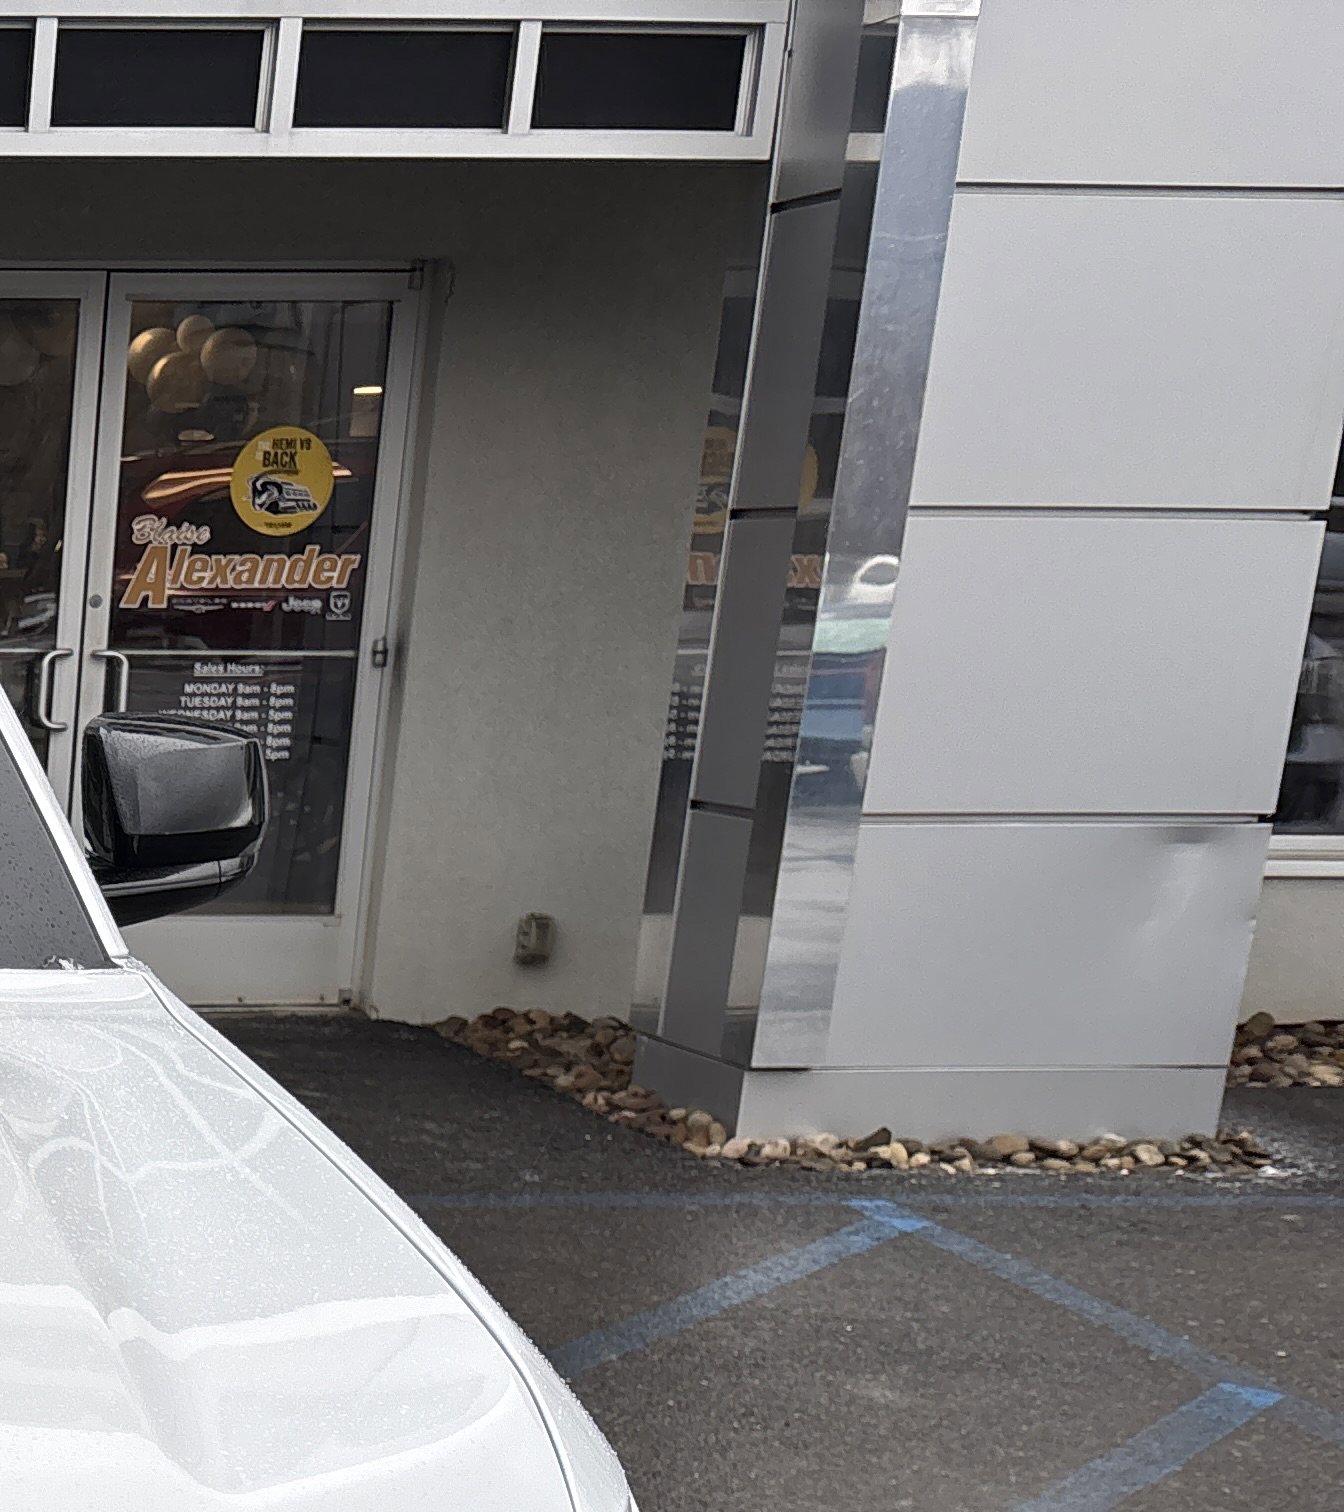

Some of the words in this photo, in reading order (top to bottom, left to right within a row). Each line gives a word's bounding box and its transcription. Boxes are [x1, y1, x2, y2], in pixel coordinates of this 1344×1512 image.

[262, 450, 298, 469] BACK
[131, 514, 212, 545] Blaise
[119, 544, 361, 608] Alexander
[193, 662, 224, 674] Sales
[184, 682, 235, 694] MONDAY
[179, 696, 235, 707] TUESDAY
